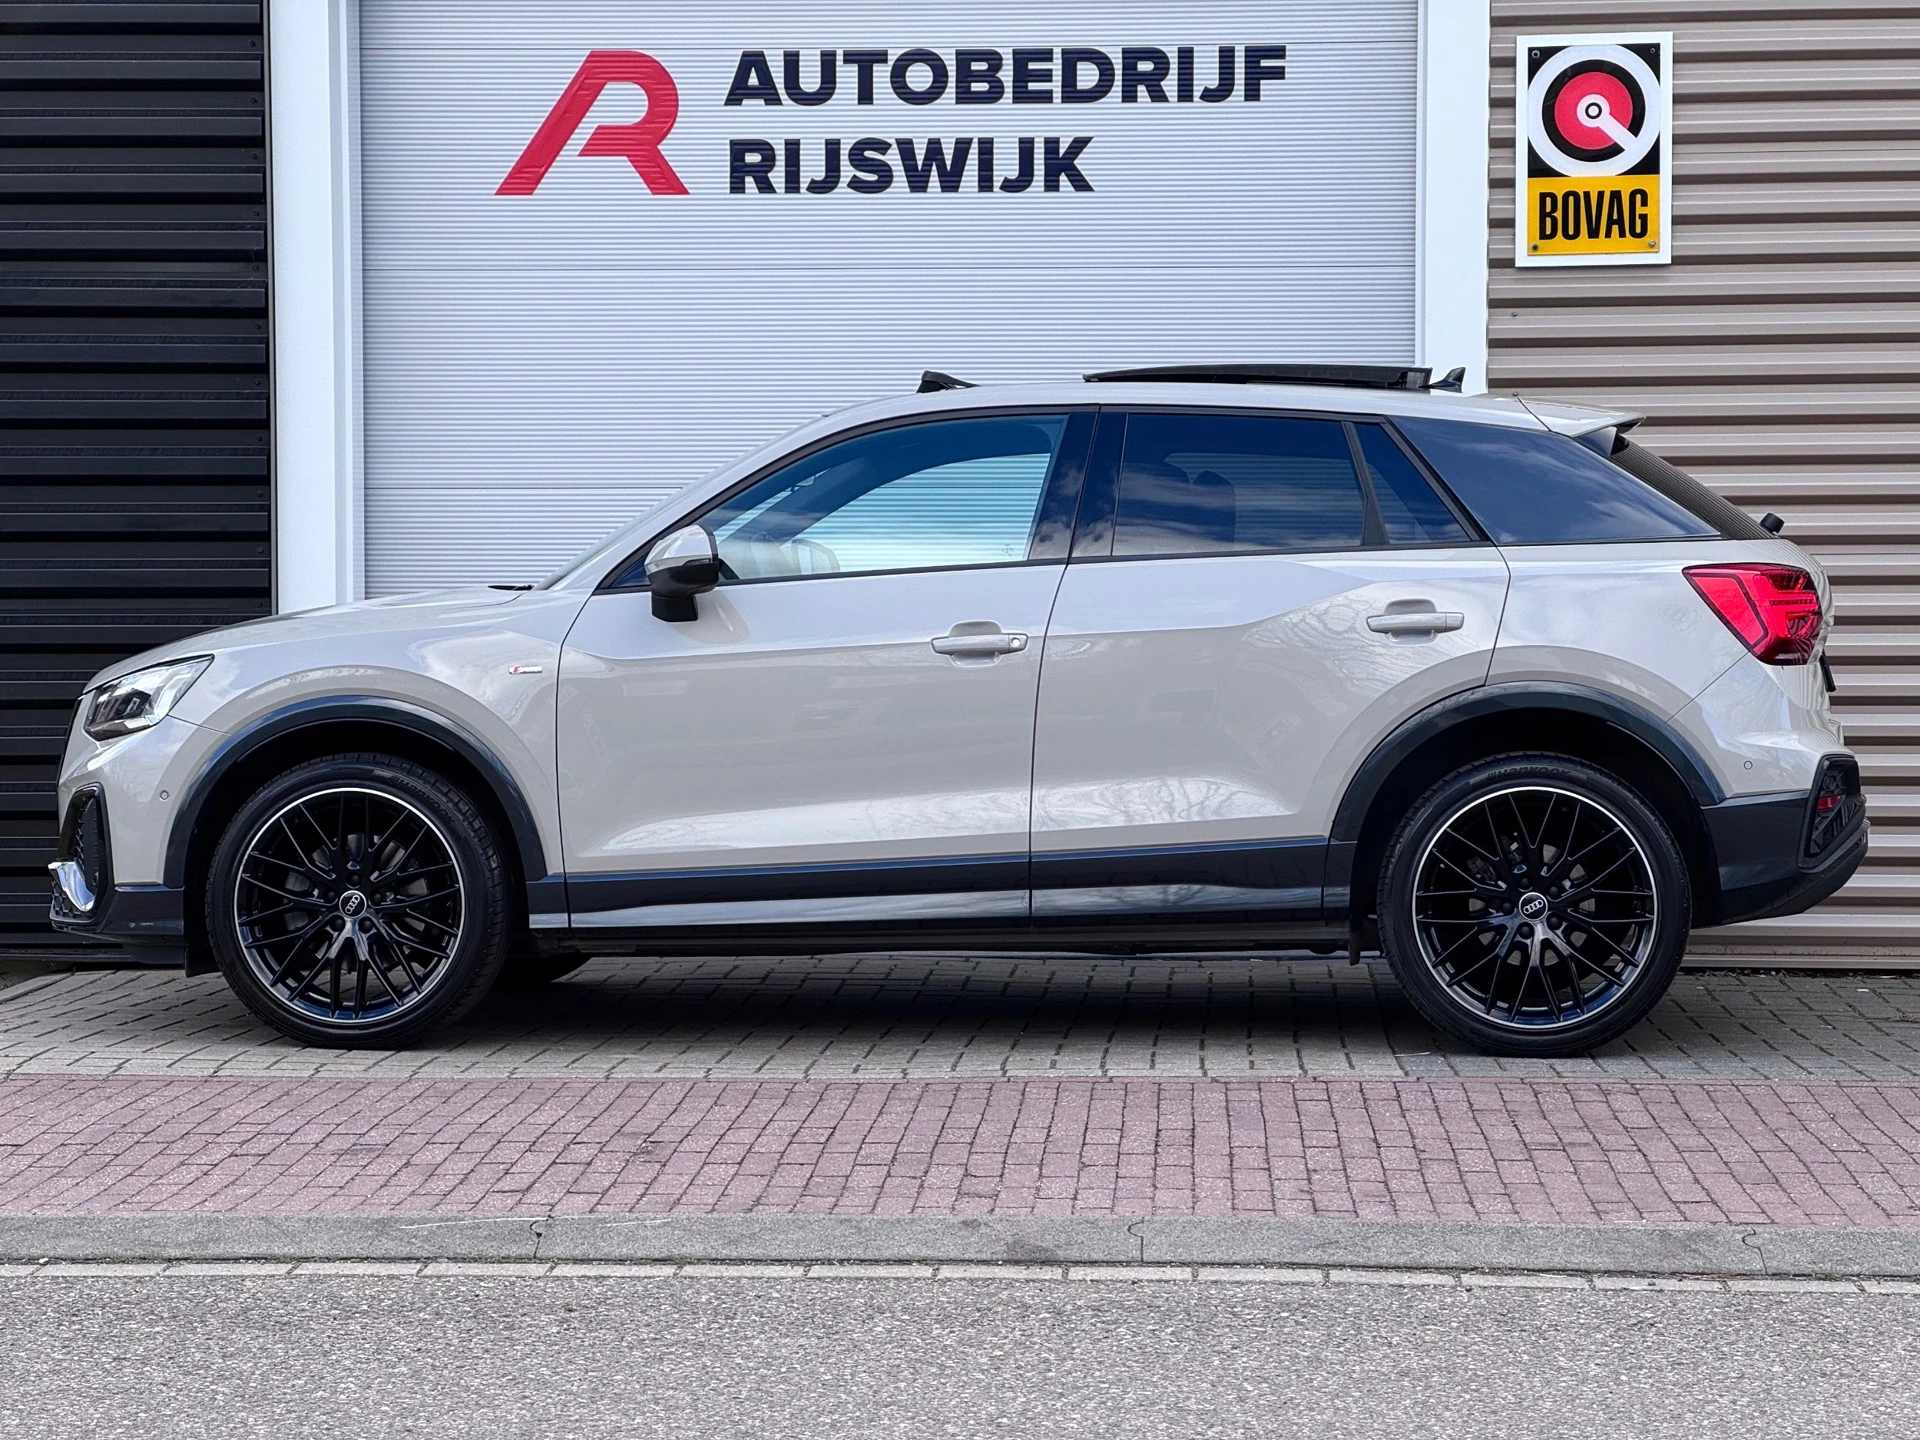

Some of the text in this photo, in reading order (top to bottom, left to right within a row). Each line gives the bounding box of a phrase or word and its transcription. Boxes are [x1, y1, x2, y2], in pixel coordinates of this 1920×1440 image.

[723, 45, 1287, 106] AUTOBEDRIJF
[729, 136, 1095, 195] RIJSWIJK
[1539, 188, 1649, 241] BOVAG
